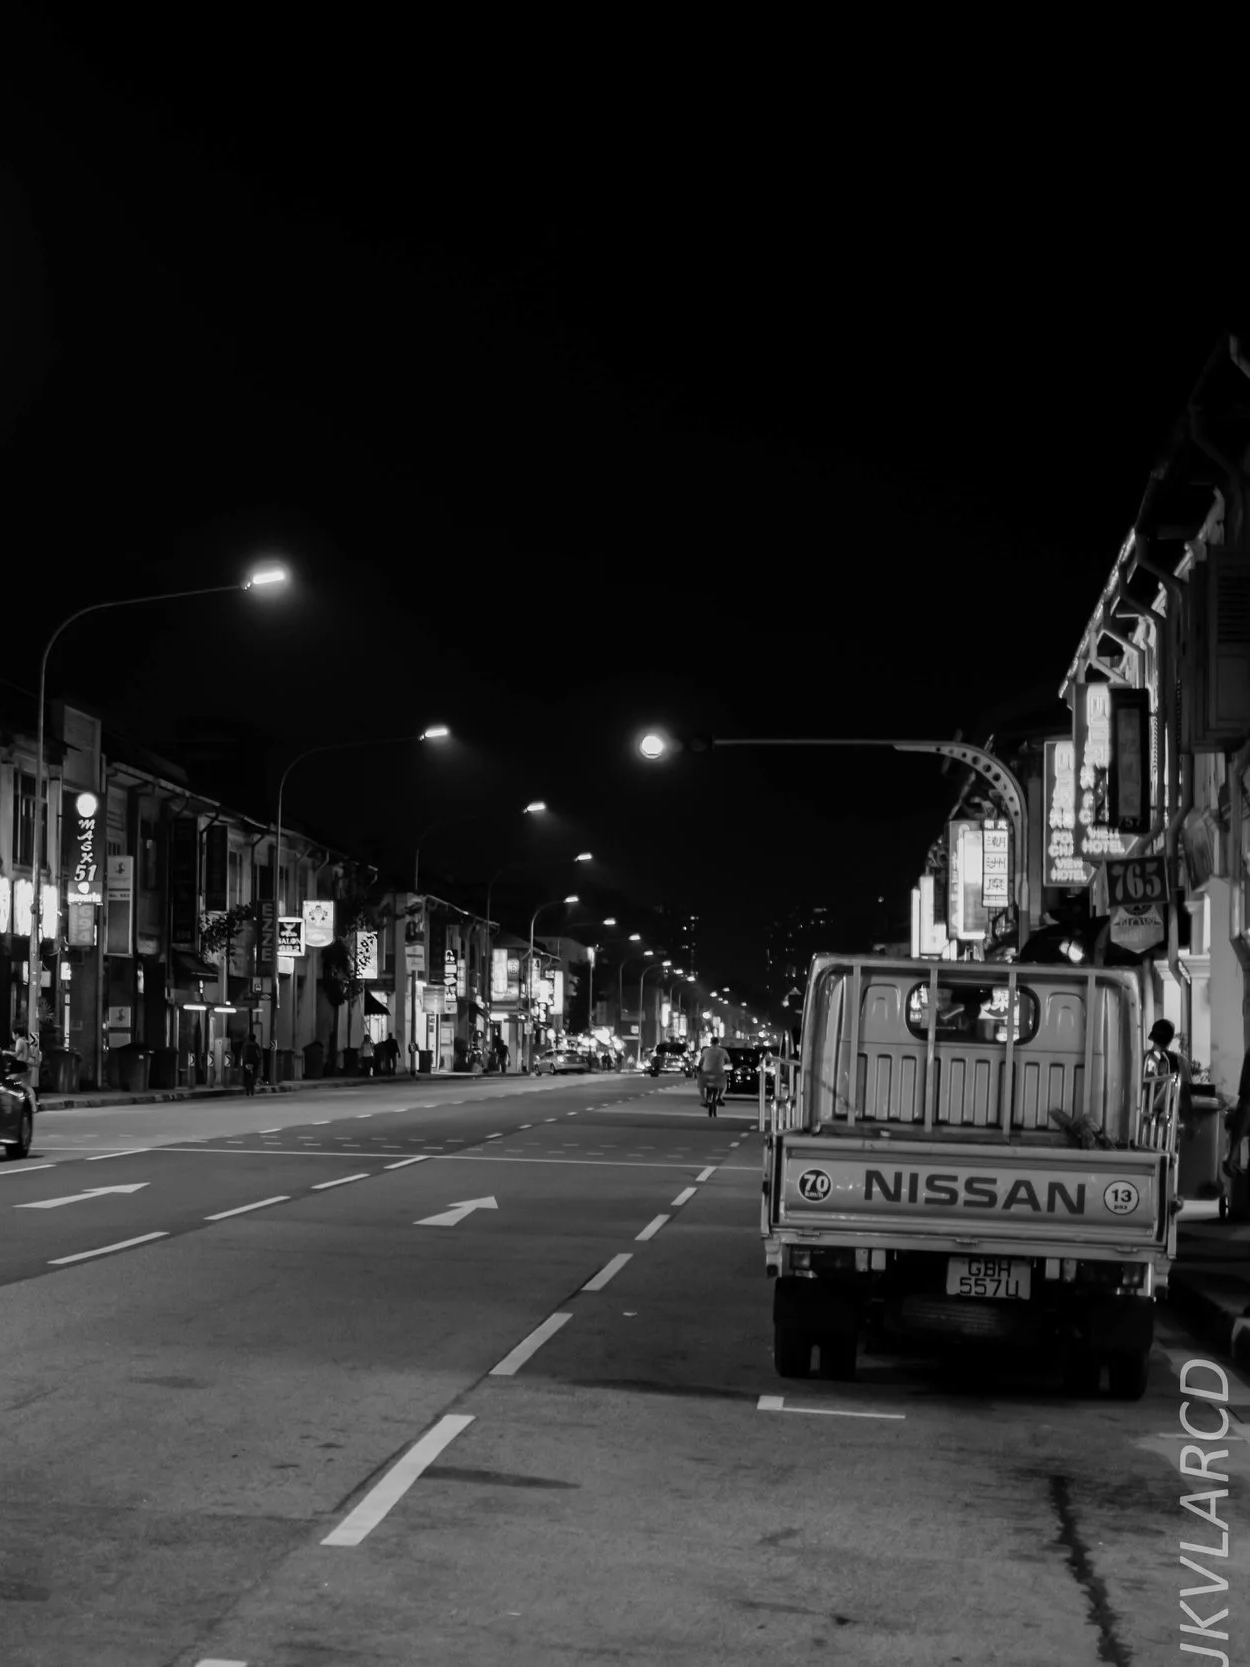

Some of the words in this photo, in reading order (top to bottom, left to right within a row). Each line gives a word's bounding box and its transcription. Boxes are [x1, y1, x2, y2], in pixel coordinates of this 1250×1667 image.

[1082, 839, 1125, 853] HOTEL
[74, 864, 97, 882] 51
[1052, 869, 1087, 881] HOTEL
[1111, 861, 1161, 901] 765
[803, 1174, 829, 1193] 70
[864, 1169, 1086, 1215] NISSAN
[1111, 1189, 1132, 1203] 13
[968, 1259, 1011, 1278] GBH
[959, 1277, 1019, 1297] 557U
